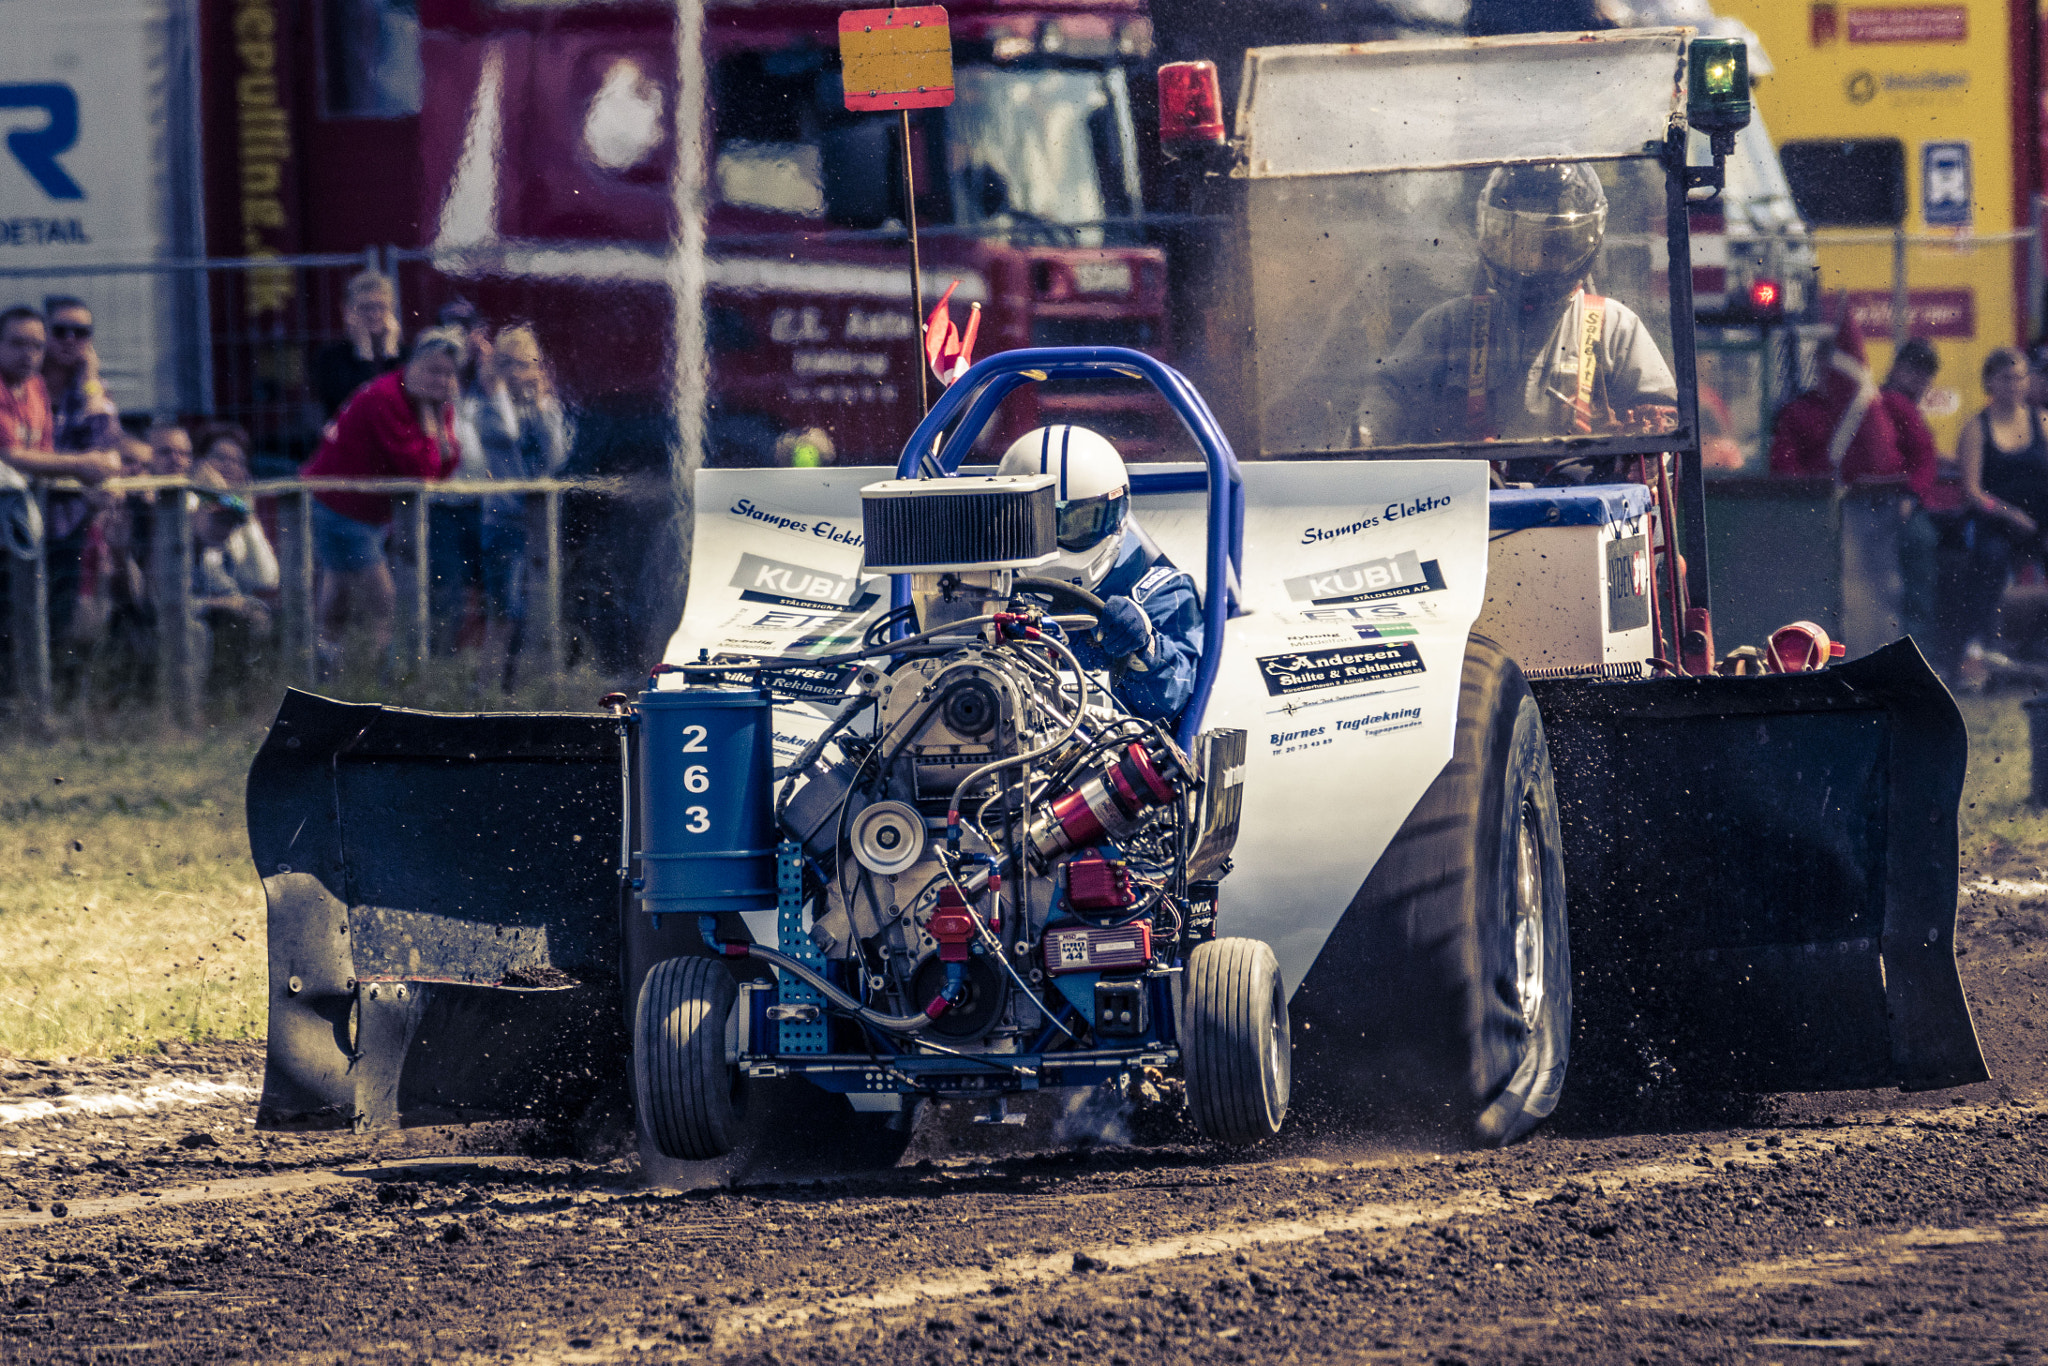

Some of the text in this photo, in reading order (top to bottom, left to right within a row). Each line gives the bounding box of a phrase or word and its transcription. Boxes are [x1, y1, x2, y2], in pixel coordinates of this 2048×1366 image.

[730, 499, 864, 548] Stampes Elektr
[1301, 495, 1451, 545] Stampes Elektro
[754, 564, 847, 600] KUBI
[1310, 561, 1404, 597] KUBI
[1353, 585, 1431, 601] STÅLDESIGN A/S
[780, 599, 834, 610] STÅLDESIGN
[1302, 603, 1407, 621] ETS
[1294, 650, 1401, 669] Andersen
[1279, 660, 1419, 686] Skilte & Reklamer
[772, 677, 843, 696] Reklamer
[1270, 707, 1421, 746] Bjarnes Tagdækning
[1189, 900, 1211, 914] WIX
[1066, 952, 1084, 961] 44
